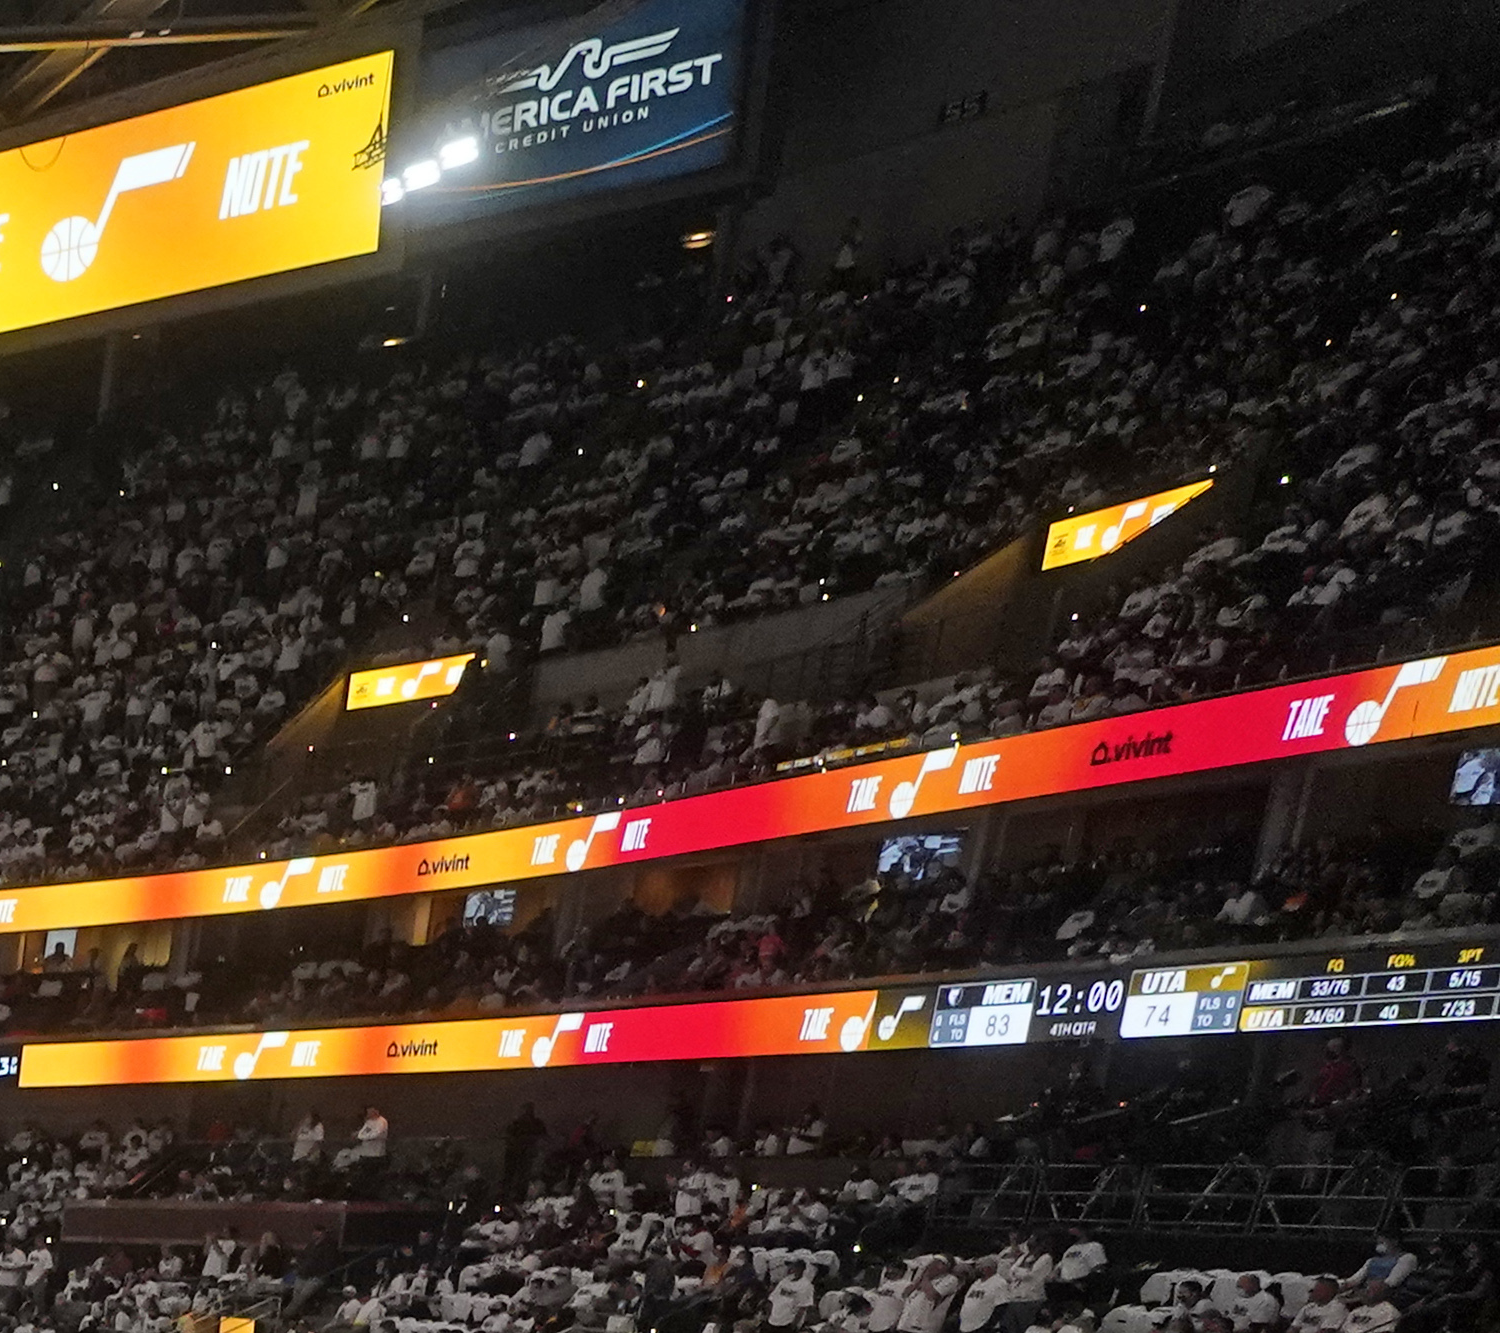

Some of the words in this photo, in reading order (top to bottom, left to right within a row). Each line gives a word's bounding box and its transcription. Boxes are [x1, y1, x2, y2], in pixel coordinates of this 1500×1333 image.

[330, 73, 376, 97] vivint
[606, 54, 723, 113] FIRST
[494, 126, 569, 154] CREDIT
[582, 106, 648, 135] UNION
[218, 139, 310, 223] NOTE
[1282, 694, 1336, 742] TAKE
[1112, 730, 1174, 764] vivint
[429, 853, 471, 875] vivint
[1456, 947, 1484, 965] 3PT
[980, 981, 1033, 1007] MEM
[1141, 970, 1188, 995] UTA
[1249, 980, 1296, 1000] MEM
[1310, 979, 1349, 997] 33/76
[1386, 974, 1406, 992] 43
[1449, 970, 1482, 989] 5/15
[1035, 979, 1124, 1017] 12:00
[985, 1013, 1011, 1037] 83
[1146, 1004, 1170, 1028] 74
[1250, 1007, 1284, 1028] UTA
[1303, 1005, 1344, 1025] 24/60
[1378, 1003, 1400, 1020] 40
[1440, 999, 1475, 1017] 7/33
[397, 1039, 439, 1058] vivint
